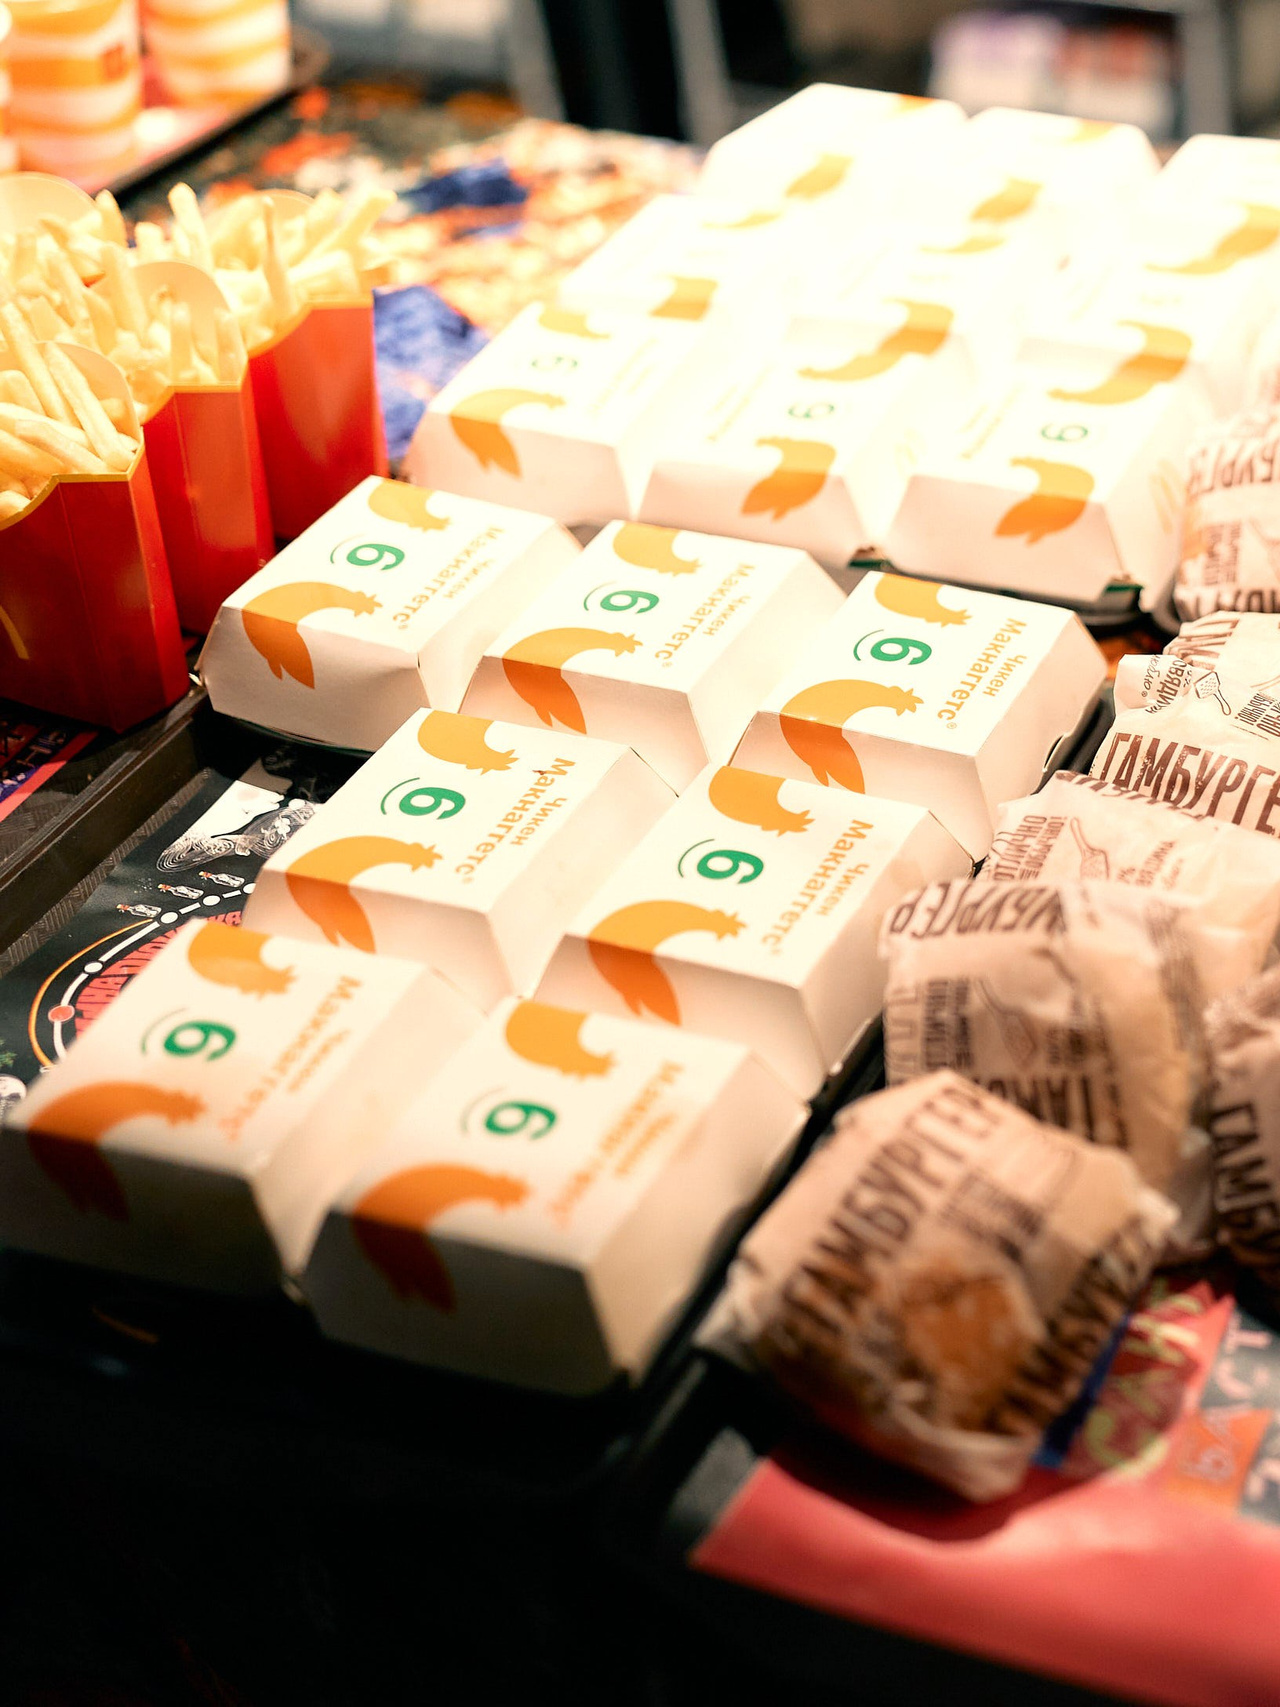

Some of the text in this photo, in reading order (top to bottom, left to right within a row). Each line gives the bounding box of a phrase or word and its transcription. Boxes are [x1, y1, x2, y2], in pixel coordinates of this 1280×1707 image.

[347, 543, 406, 571] 6
[600, 588, 660, 615] 6
[702, 594, 754, 637] Чикен
[870, 635, 933, 666] 6
[981, 654, 1028, 698] Чикен
[398, 786, 467, 820] 6
[508, 796, 570, 847] Чикен
[697, 849, 764, 885] 6
[813, 861, 871, 917] Чикен
[164, 1019, 238, 1062] 6
[485, 1100, 558, 1141] 6
